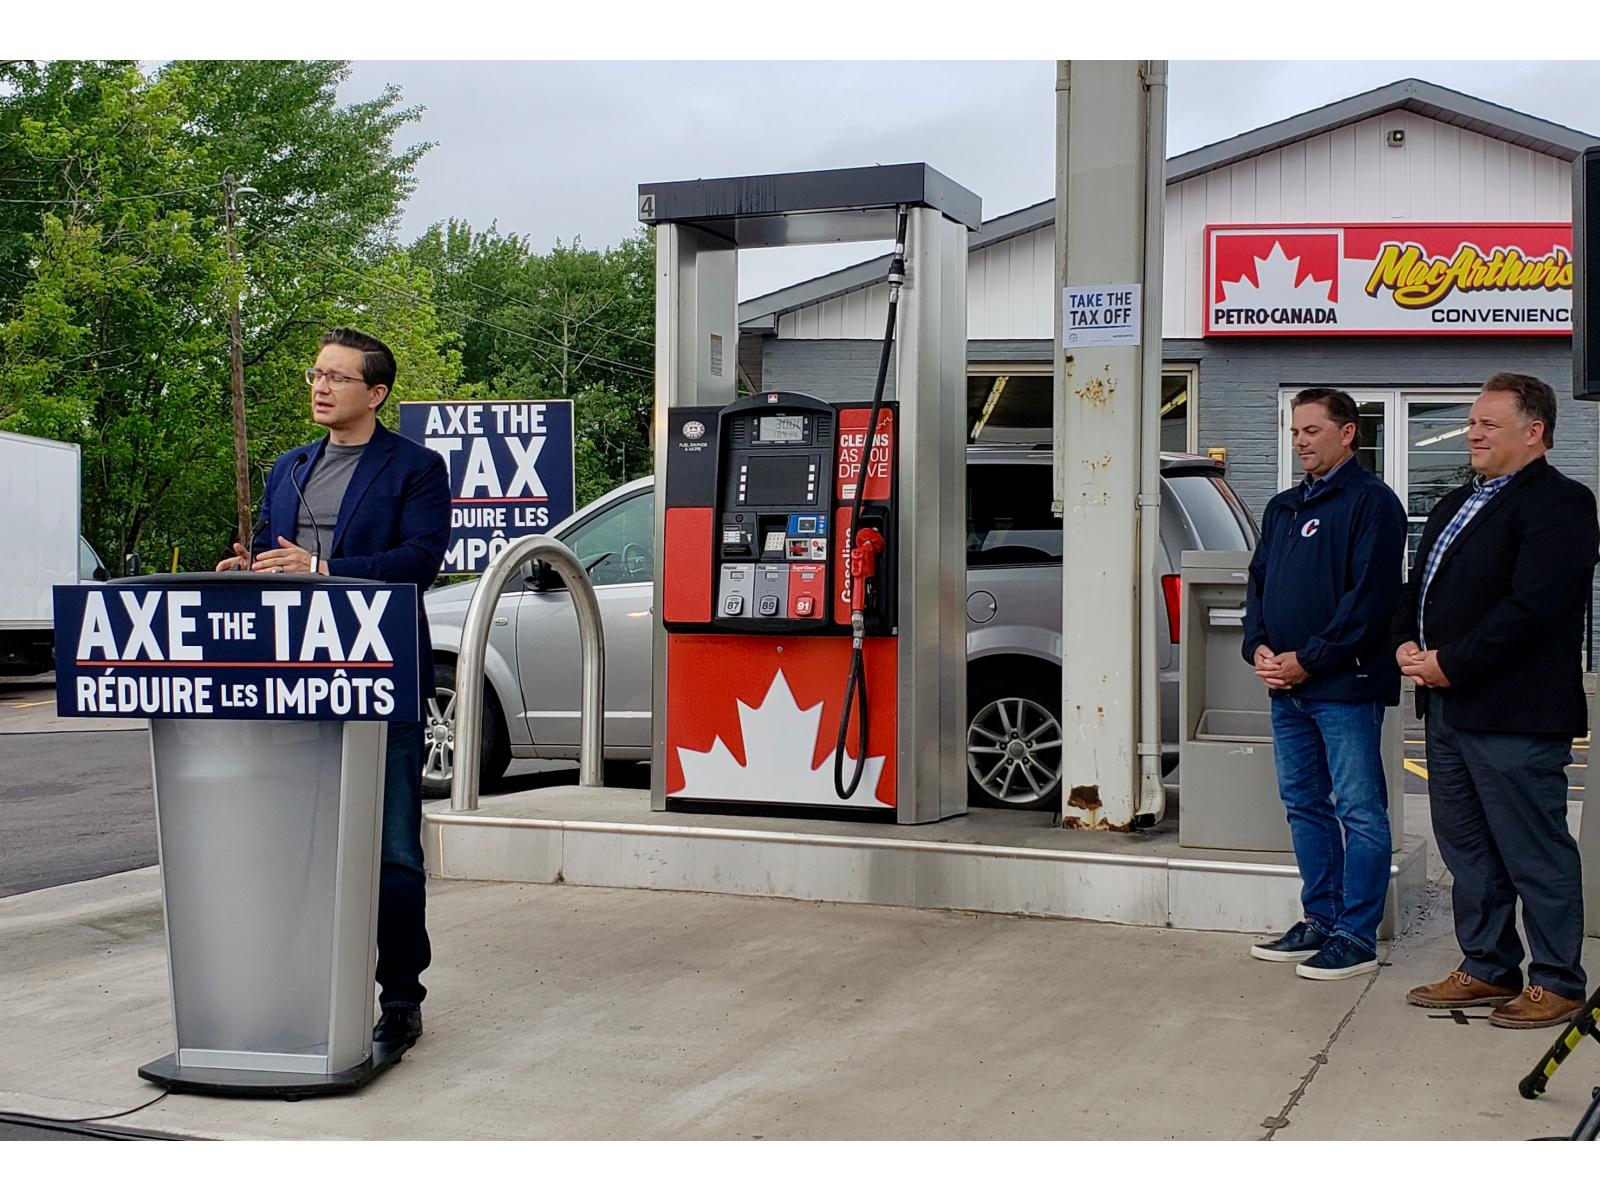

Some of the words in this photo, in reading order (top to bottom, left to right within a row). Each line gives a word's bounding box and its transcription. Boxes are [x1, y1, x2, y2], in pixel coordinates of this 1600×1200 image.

[641, 196, 654, 217] 4
[1365, 242, 1572, 308] MacArthur's
[1069, 293, 1103, 308] TAKE
[1106, 291, 1132, 306] THE
[1069, 309, 1099, 326] TAX
[1103, 307, 1132, 325] OFF
[1431, 308, 1573, 323] CONVENIENC
[425, 404, 483, 434] AXE
[491, 403, 547, 434] THE
[839, 448, 859, 463] AS
[863, 448, 889, 462] OU
[424, 436, 548, 498] TAX
[838, 463, 888, 478] DRVE
[450, 507, 507, 528] DUIRE
[514, 506, 549, 527] LES
[727, 601, 740, 610] 87
[762, 601, 775, 610] 89
[796, 601, 810, 611] 91
[76, 590, 204, 661] AXE
[208, 611, 257, 641] THE
[261, 590, 394, 662] TAX
[76, 667, 214, 713] RÉDUIRE
[220, 684, 258, 708] LES
[265, 669, 395, 715] IMPÔTS
